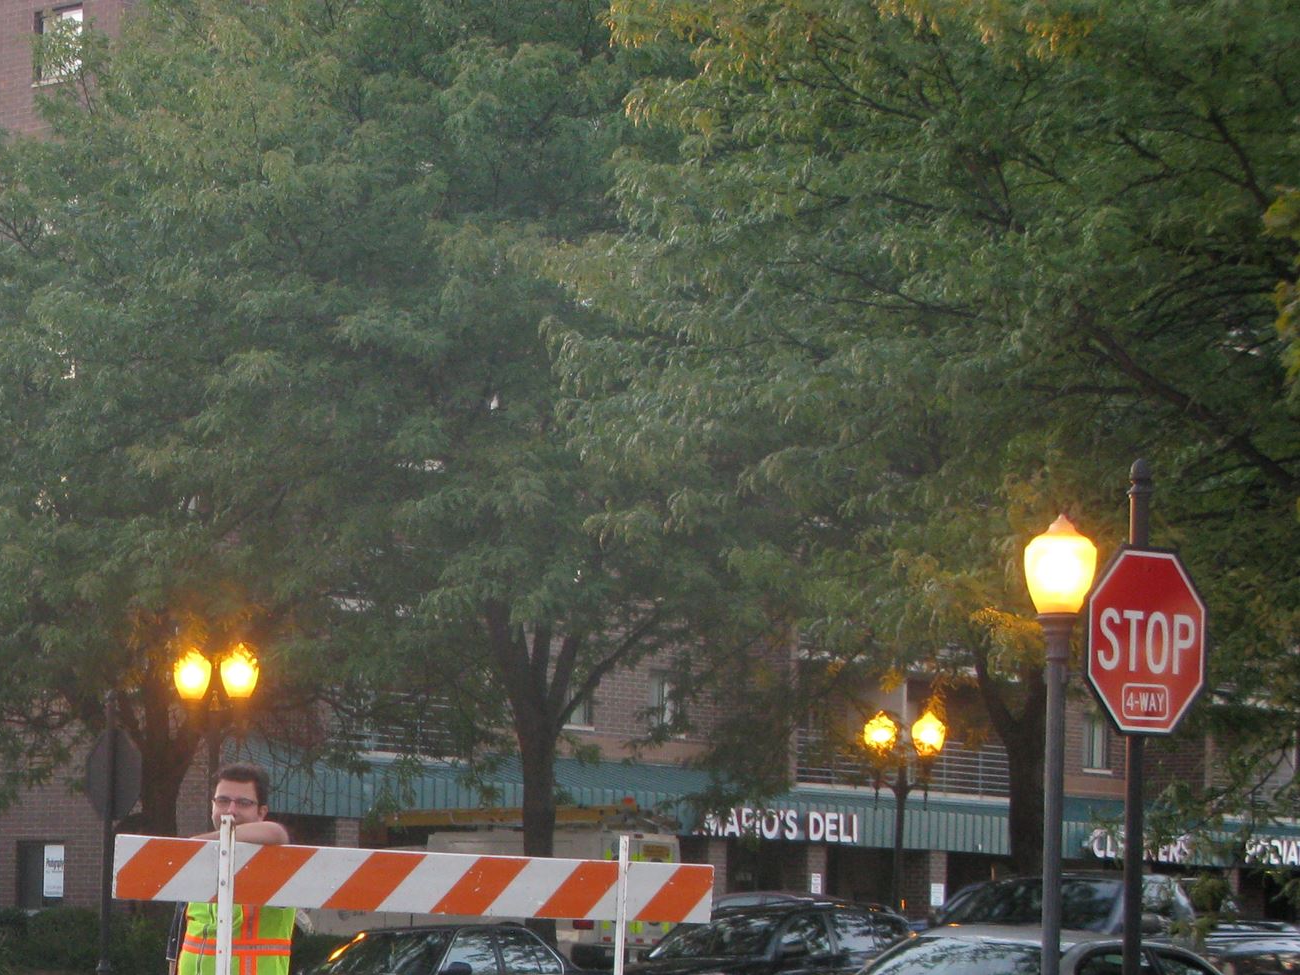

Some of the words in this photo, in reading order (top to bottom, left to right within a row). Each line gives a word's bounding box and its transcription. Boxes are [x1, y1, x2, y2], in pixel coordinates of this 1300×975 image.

[1097, 607, 1196, 675] STOP
[1125, 692, 1165, 712] 4-WAY
[808, 811, 858, 843] DELI
